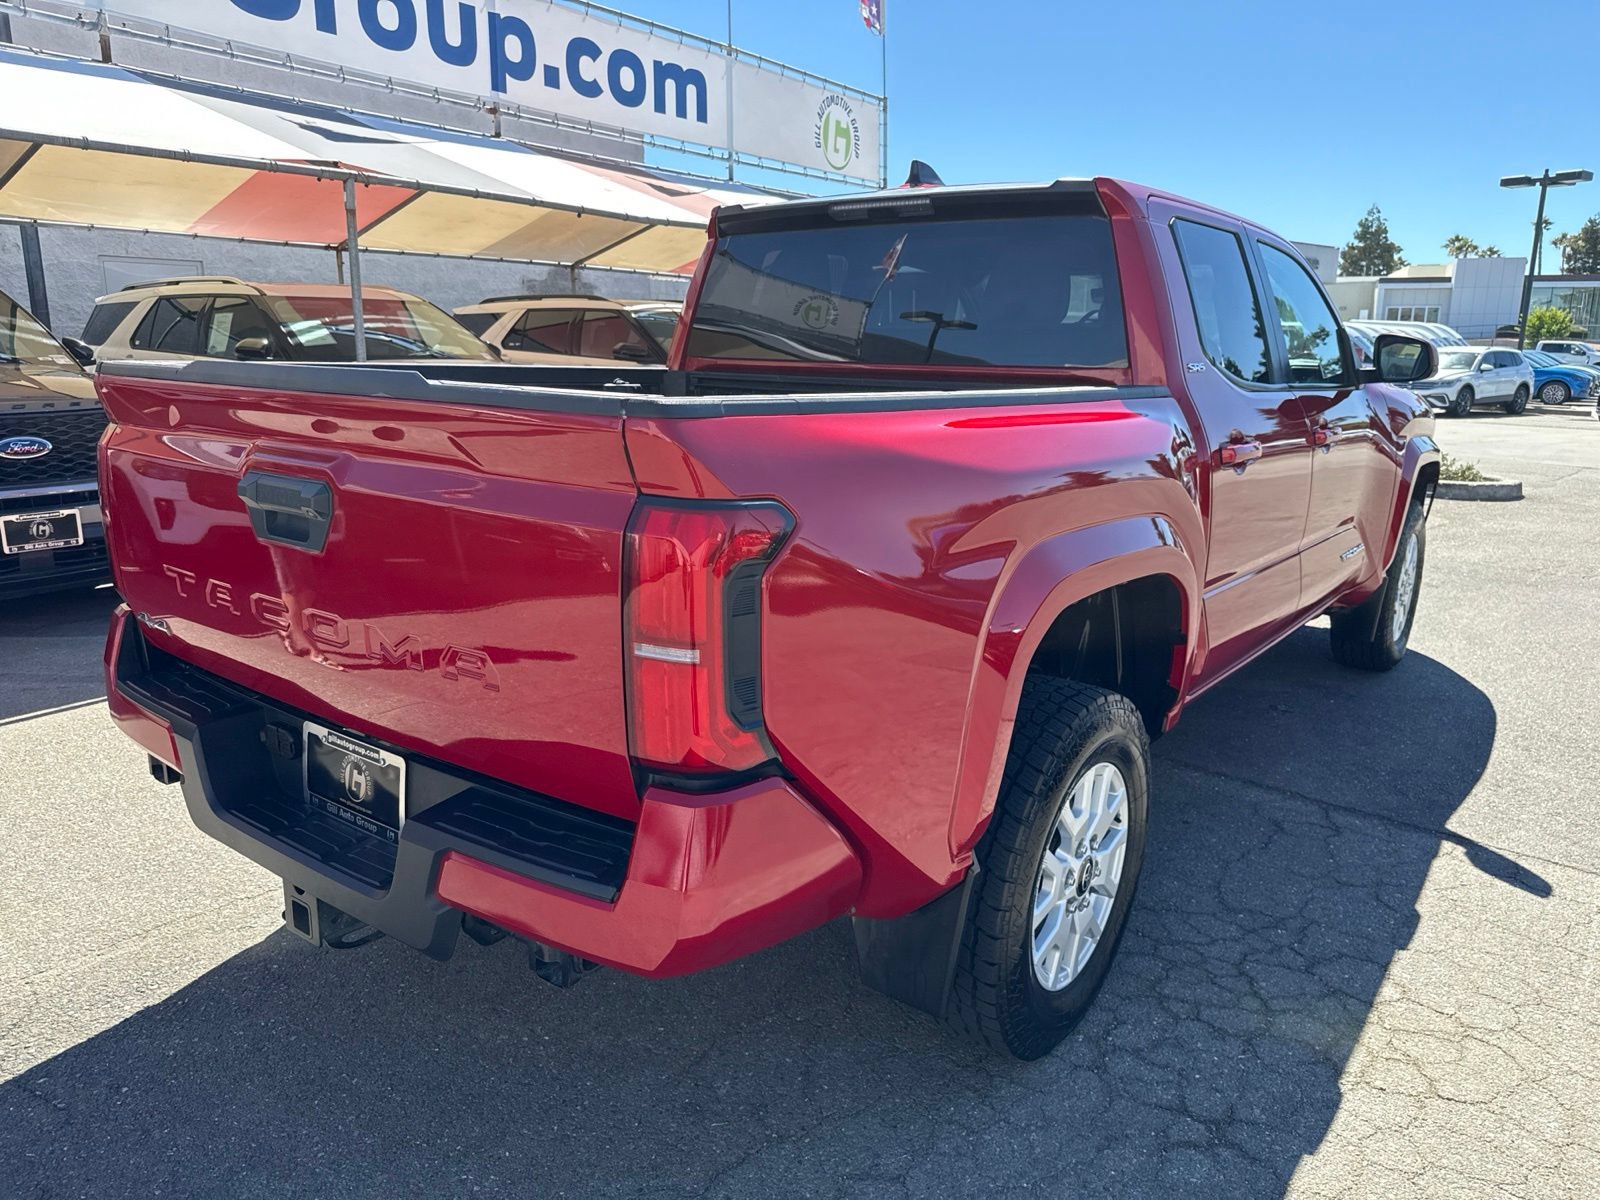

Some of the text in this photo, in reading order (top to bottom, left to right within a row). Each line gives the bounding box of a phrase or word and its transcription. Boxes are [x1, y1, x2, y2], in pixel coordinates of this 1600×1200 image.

[228, 0, 709, 124] oup.com
[814, 94, 861, 159] GILL AUTOMOTIVE GROUP
[6, 441, 40, 453] Ford
[162, 562, 500, 693] TACOMA
[326, 803, 338, 815] Gill
[340, 808, 355, 822] Auto
[356, 816, 378, 833] Group
